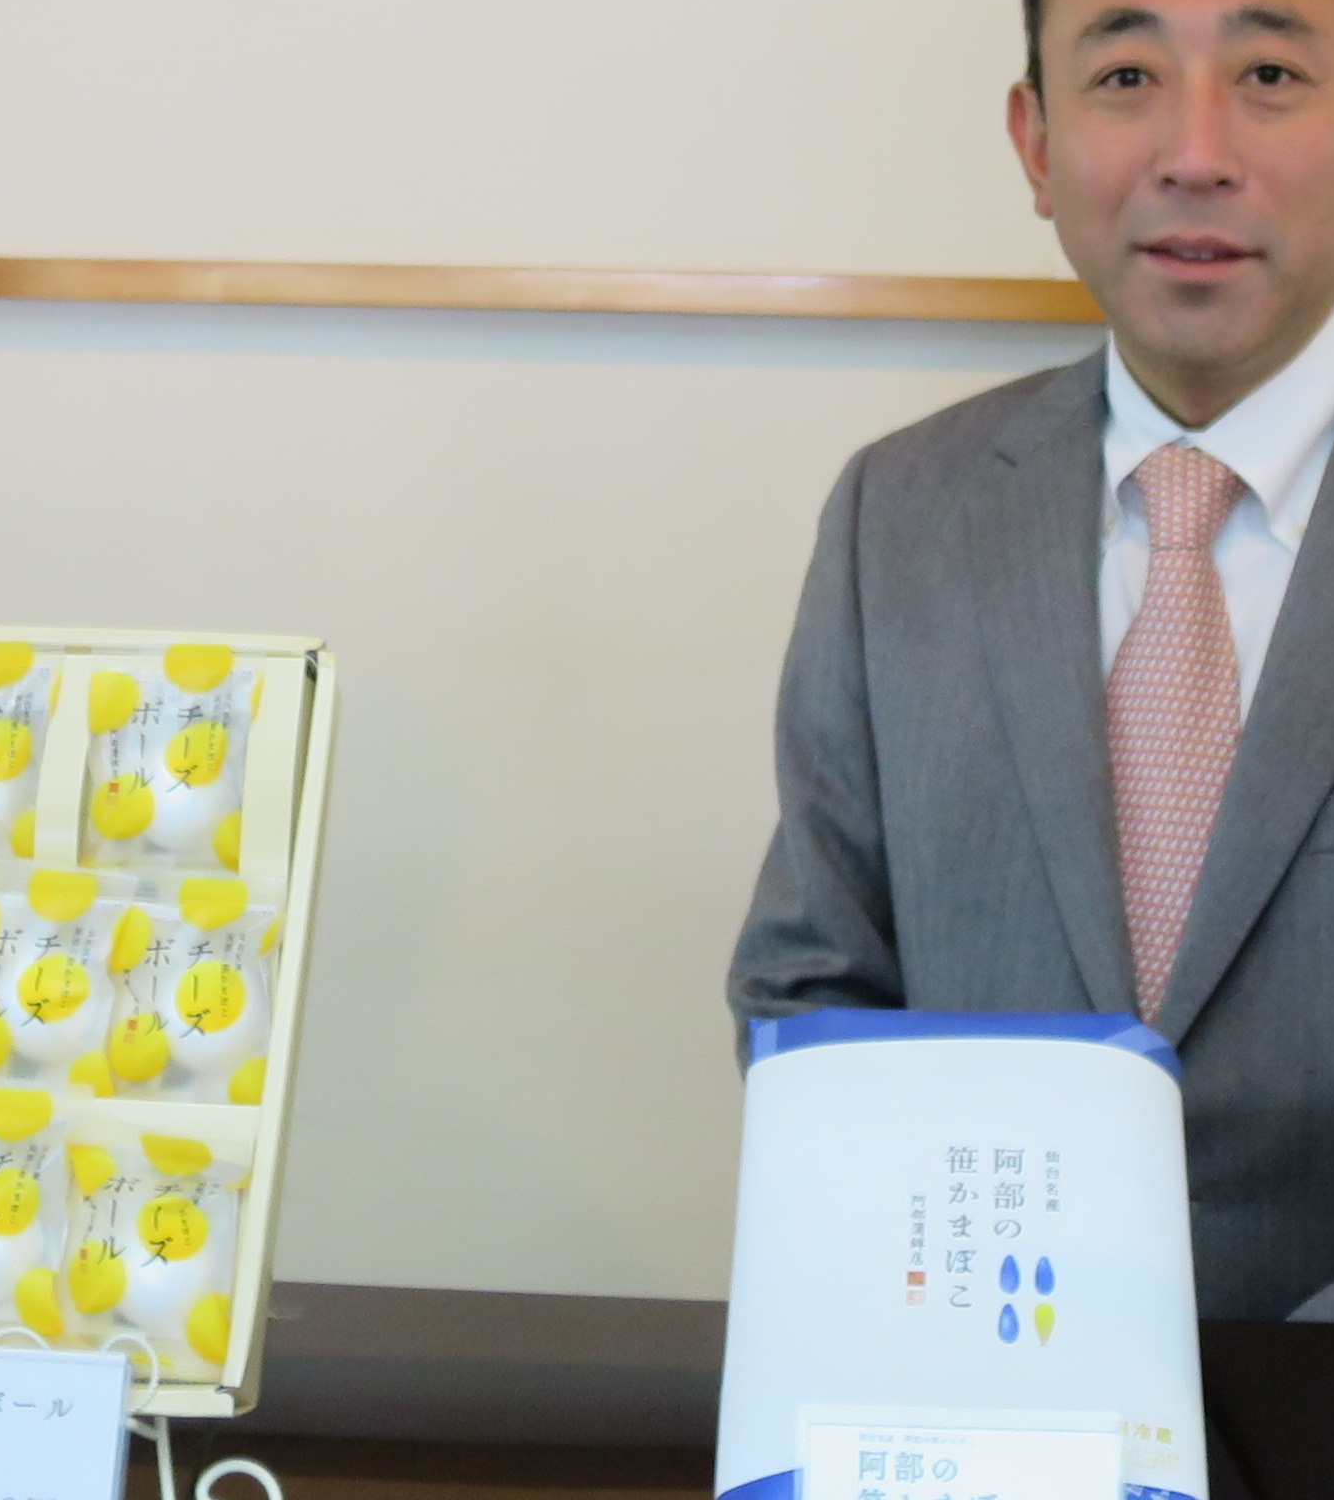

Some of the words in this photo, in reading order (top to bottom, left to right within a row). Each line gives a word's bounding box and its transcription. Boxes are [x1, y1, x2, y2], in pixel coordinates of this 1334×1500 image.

[128, 697, 165, 796] ボール
[166, 705, 204, 793] チーズ
[20, 934, 61, 1027] チーズ
[142, 938, 177, 1037] ボール
[179, 940, 215, 1039] チーズ
[97, 1176, 141, 1267] ボール
[140, 1184, 182, 1268] チーズ
[945, 1145, 979, 1308] 笹かまぼこ
[993, 1148, 1026, 1240] 阿部の
[1044, 1150, 1061, 1213] 仙台名産
[858, 1450, 958, 1484] 阿部の
